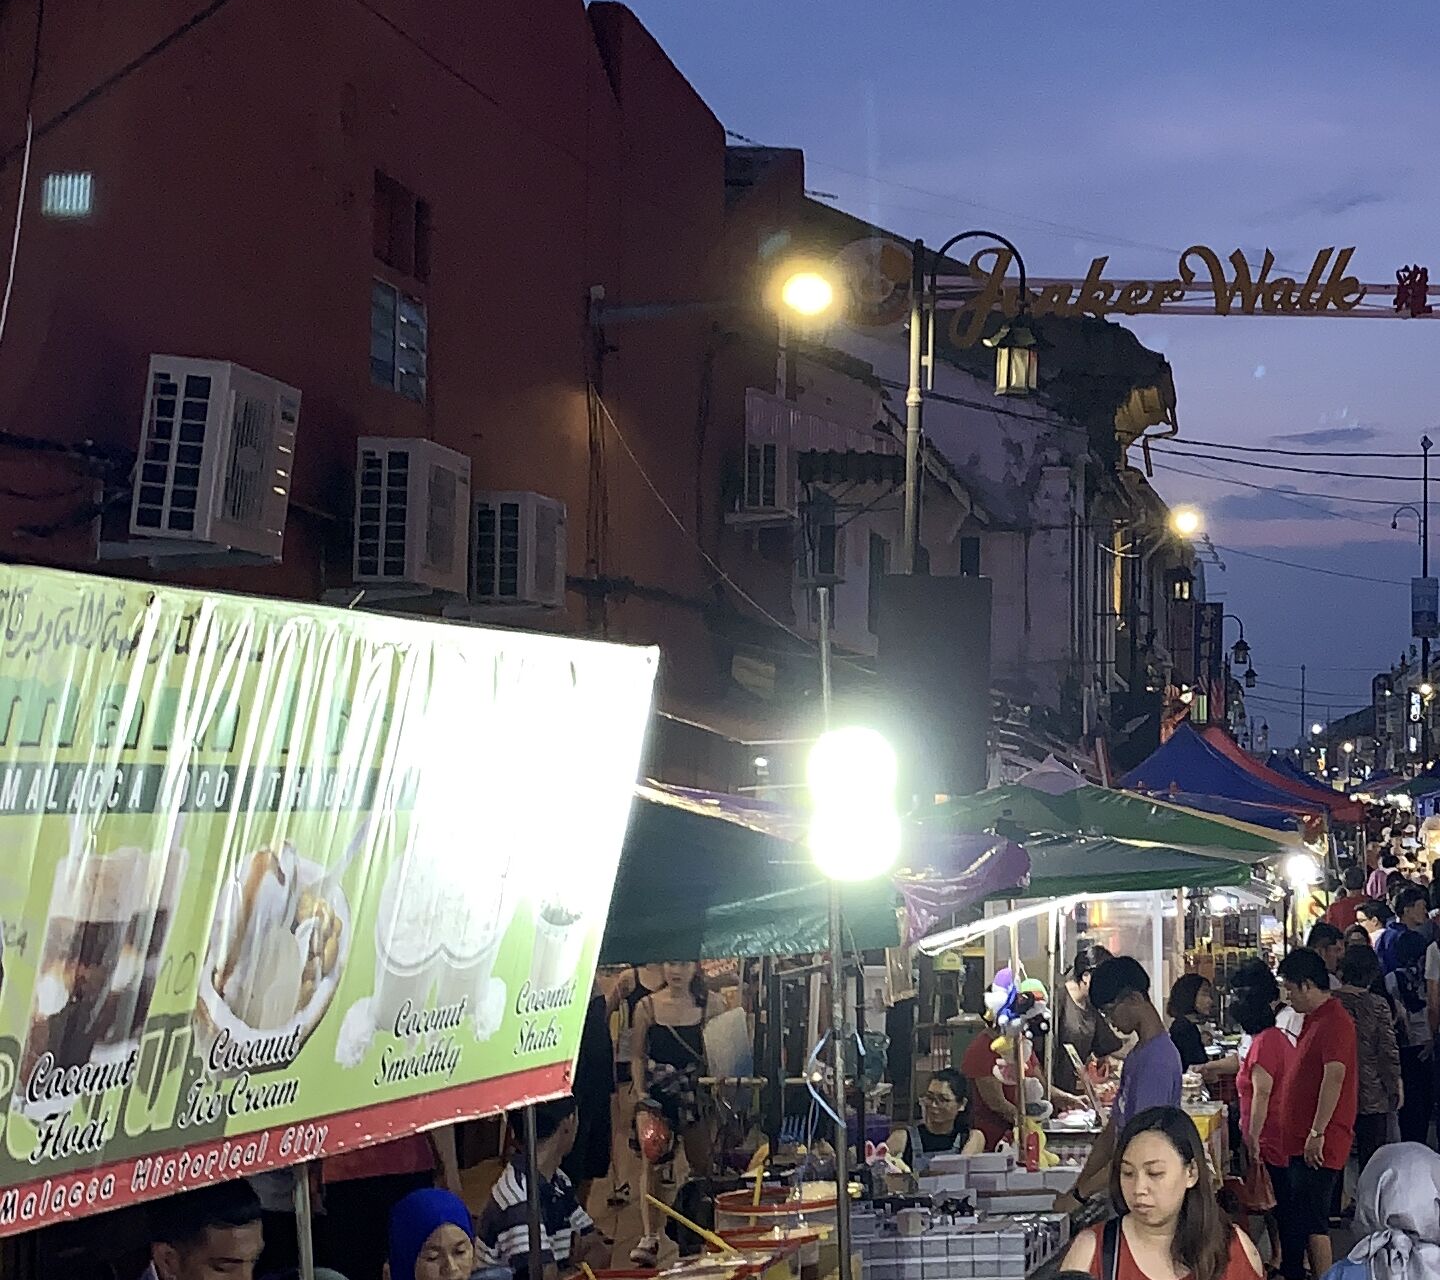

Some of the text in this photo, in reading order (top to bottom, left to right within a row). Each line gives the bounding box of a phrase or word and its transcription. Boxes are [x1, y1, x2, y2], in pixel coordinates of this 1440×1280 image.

[1180, 245, 1367, 315] Walk
[0, 768, 144, 811] MALACCA
[394, 994, 468, 1039] Coconut
[516, 979, 578, 1016] Coconut
[208, 1026, 301, 1073] Coconut
[374, 1036, 462, 1086] Smoothly
[513, 1019, 562, 1056] Shake
[26, 1050, 138, 1105] Coconut
[177, 1072, 300, 1129] Ice Cream
[29, 1111, 110, 1164] Float
[0, 1123, 329, 1226] Malacca Historical City
